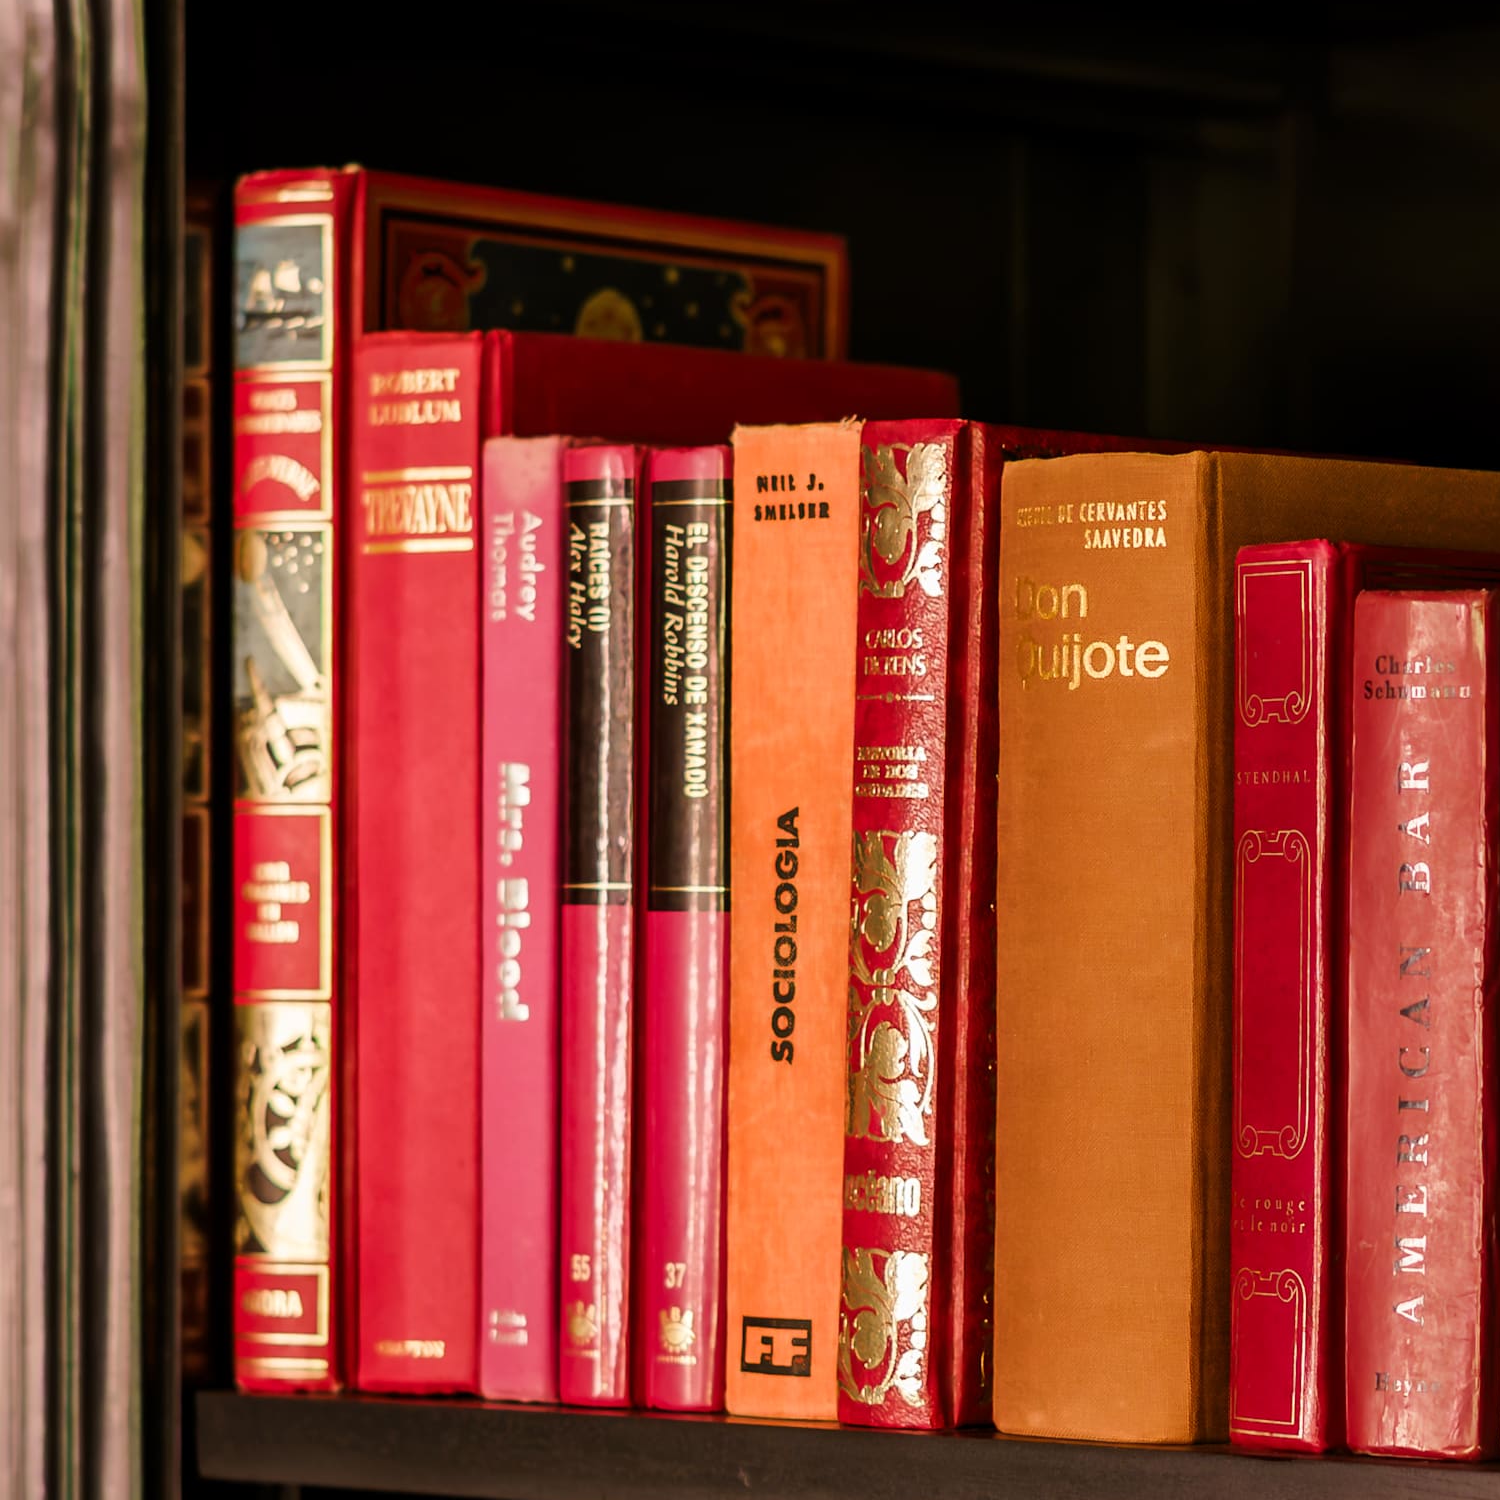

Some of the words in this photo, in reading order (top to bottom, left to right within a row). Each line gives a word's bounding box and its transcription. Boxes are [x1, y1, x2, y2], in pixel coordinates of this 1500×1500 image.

[369, 368, 460, 396] ROBERT
[369, 399, 461, 426] LUDLUM
[756, 473, 796, 493] NEIL
[806, 473, 824, 491] J.
[754, 502, 830, 522] SMELSER
[1079, 500, 1168, 523] CERVANTES
[569, 522, 587, 573] Alex
[685, 522, 708, 550] EL
[1084, 527, 1167, 549] SAAVEDRA
[491, 512, 514, 623] Thomas
[515, 510, 545, 622] Audrey
[664, 523, 685, 607] Harold
[566, 580, 588, 649] Haley
[685, 556, 709, 669] DESCENSO
[865, 628, 923, 650] CARLOS
[663, 612, 685, 706] Robbins
[1375, 655, 1456, 675] Charles
[684, 675, 708, 705] DE
[1236, 769, 1311, 786] STENDHAL
[1397, 757, 1431, 896] BAR
[771, 806, 800, 1065] SOCIOLOGIA
[1394, 942, 1431, 1327] AMERICAN
[1255, 1198, 1306, 1216] rouge
[1250, 1214, 1263, 1232] le
[1270, 1216, 1306, 1234] noir
[571, 1254, 591, 1282] 55
[664, 1262, 687, 1289] 37
